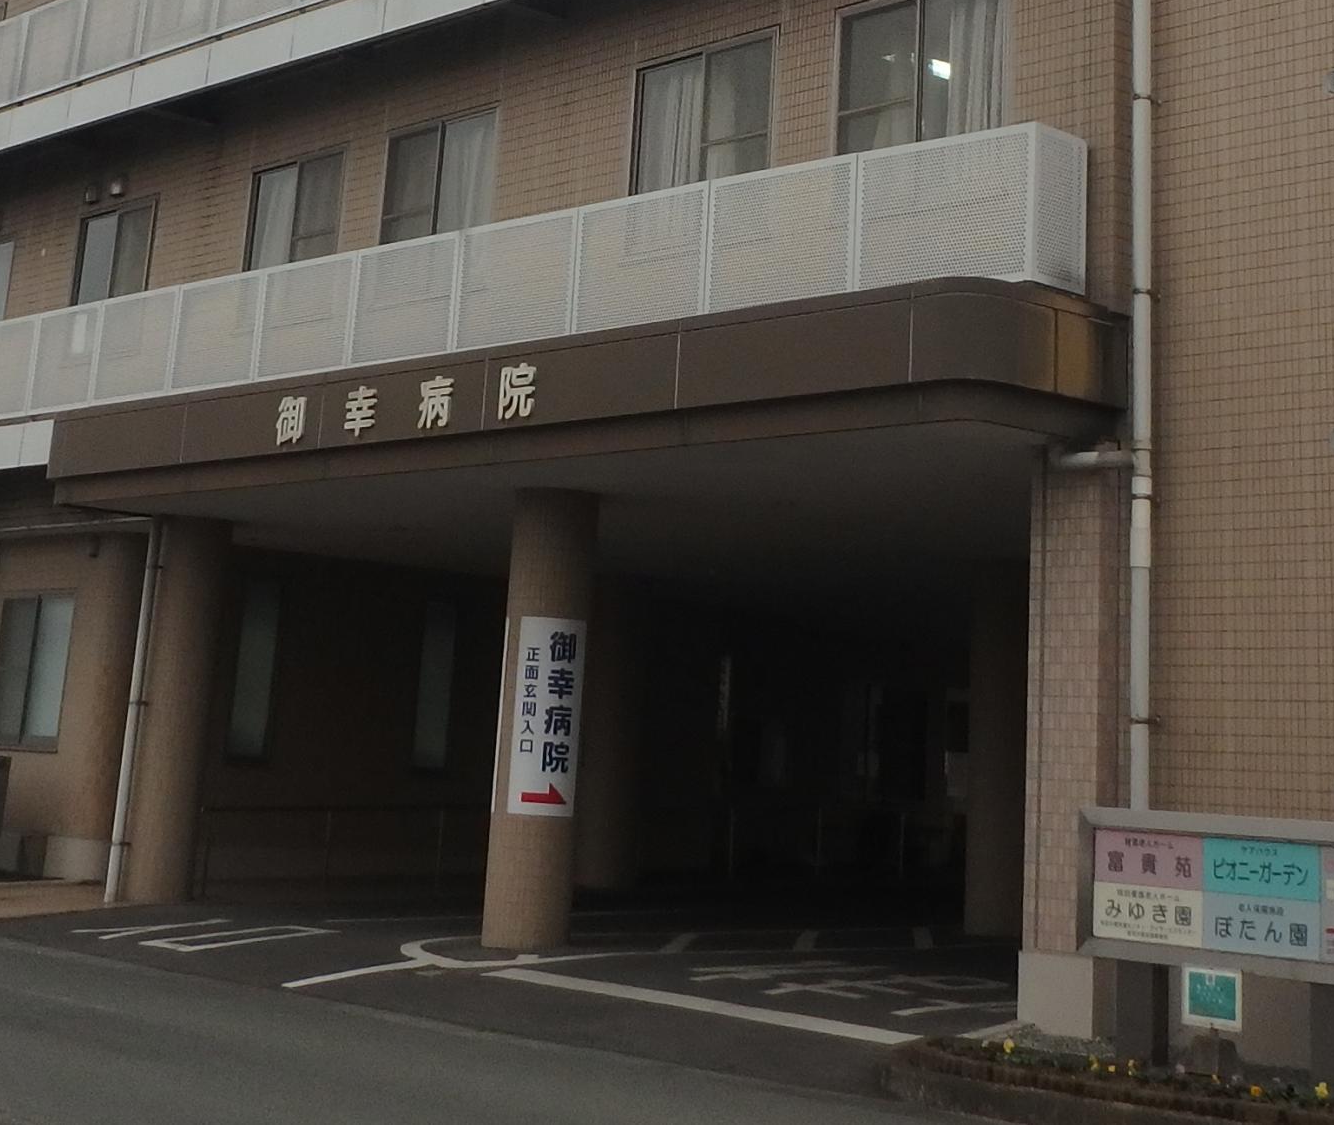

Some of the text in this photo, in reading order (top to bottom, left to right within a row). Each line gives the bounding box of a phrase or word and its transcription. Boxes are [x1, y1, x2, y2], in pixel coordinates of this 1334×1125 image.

[275, 362, 537, 446] 御幸病院
[519, 647, 541, 753] 正面玄関入口
[541, 631, 577, 774] 御幸病院
[1213, 856, 1309, 887] ピオニーガーデン
[1105, 898, 1192, 927] みゆき園
[1214, 916, 1308, 947] ぼたん園
